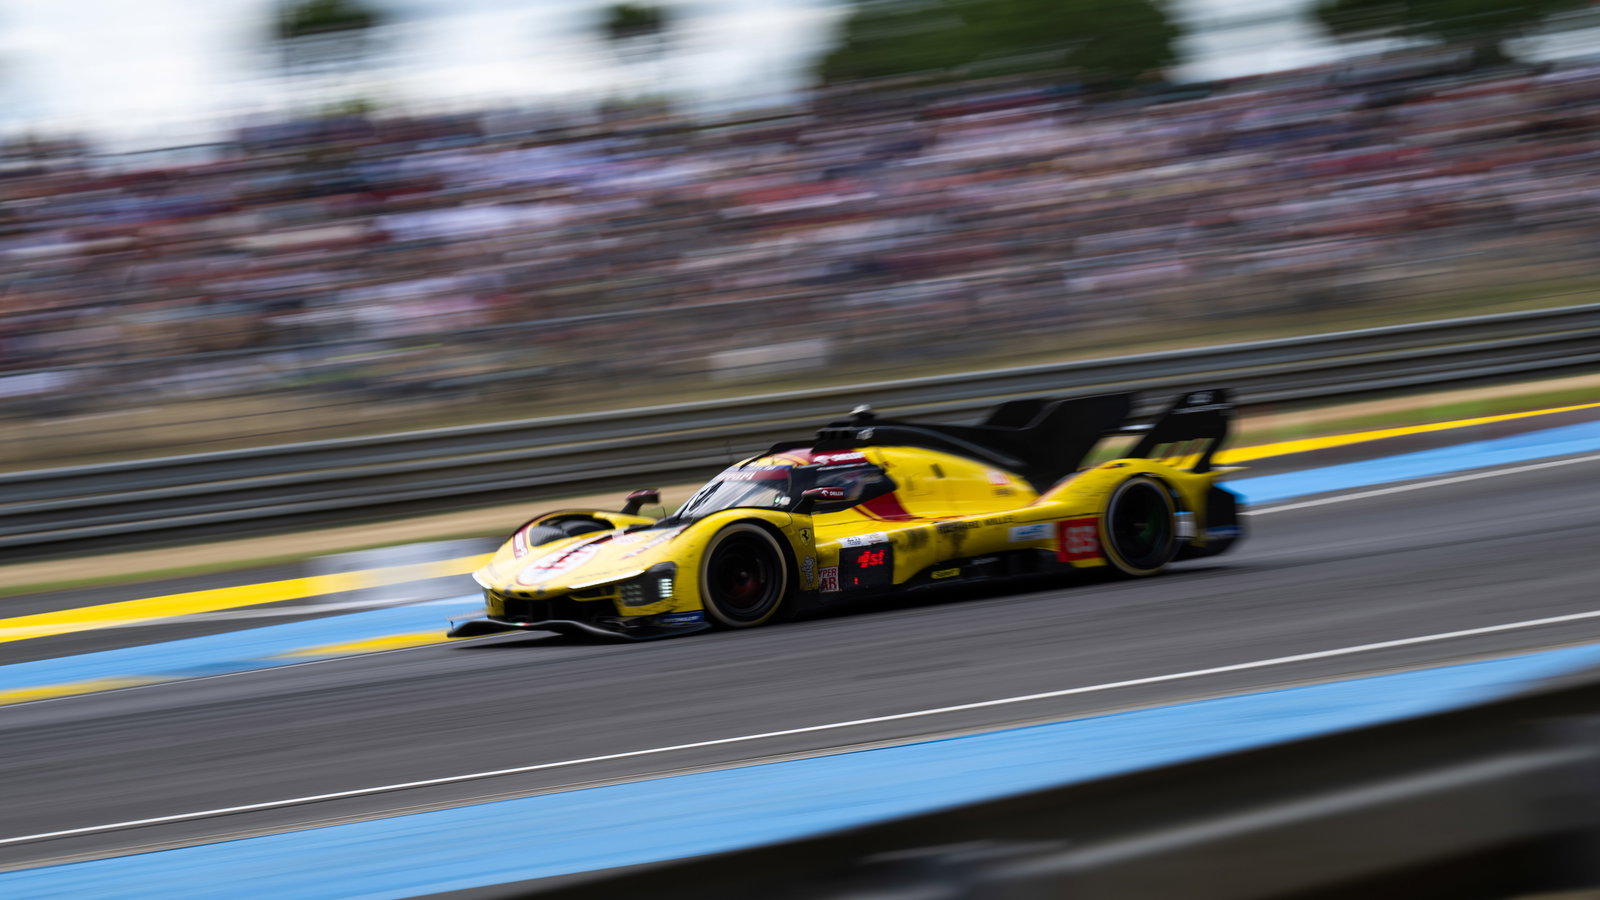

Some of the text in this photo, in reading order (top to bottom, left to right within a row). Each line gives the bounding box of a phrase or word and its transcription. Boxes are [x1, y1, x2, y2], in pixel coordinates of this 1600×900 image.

[1064, 525, 1099, 554] 83
[818, 568, 837, 577] YPER
[820, 577, 837, 591] AR
